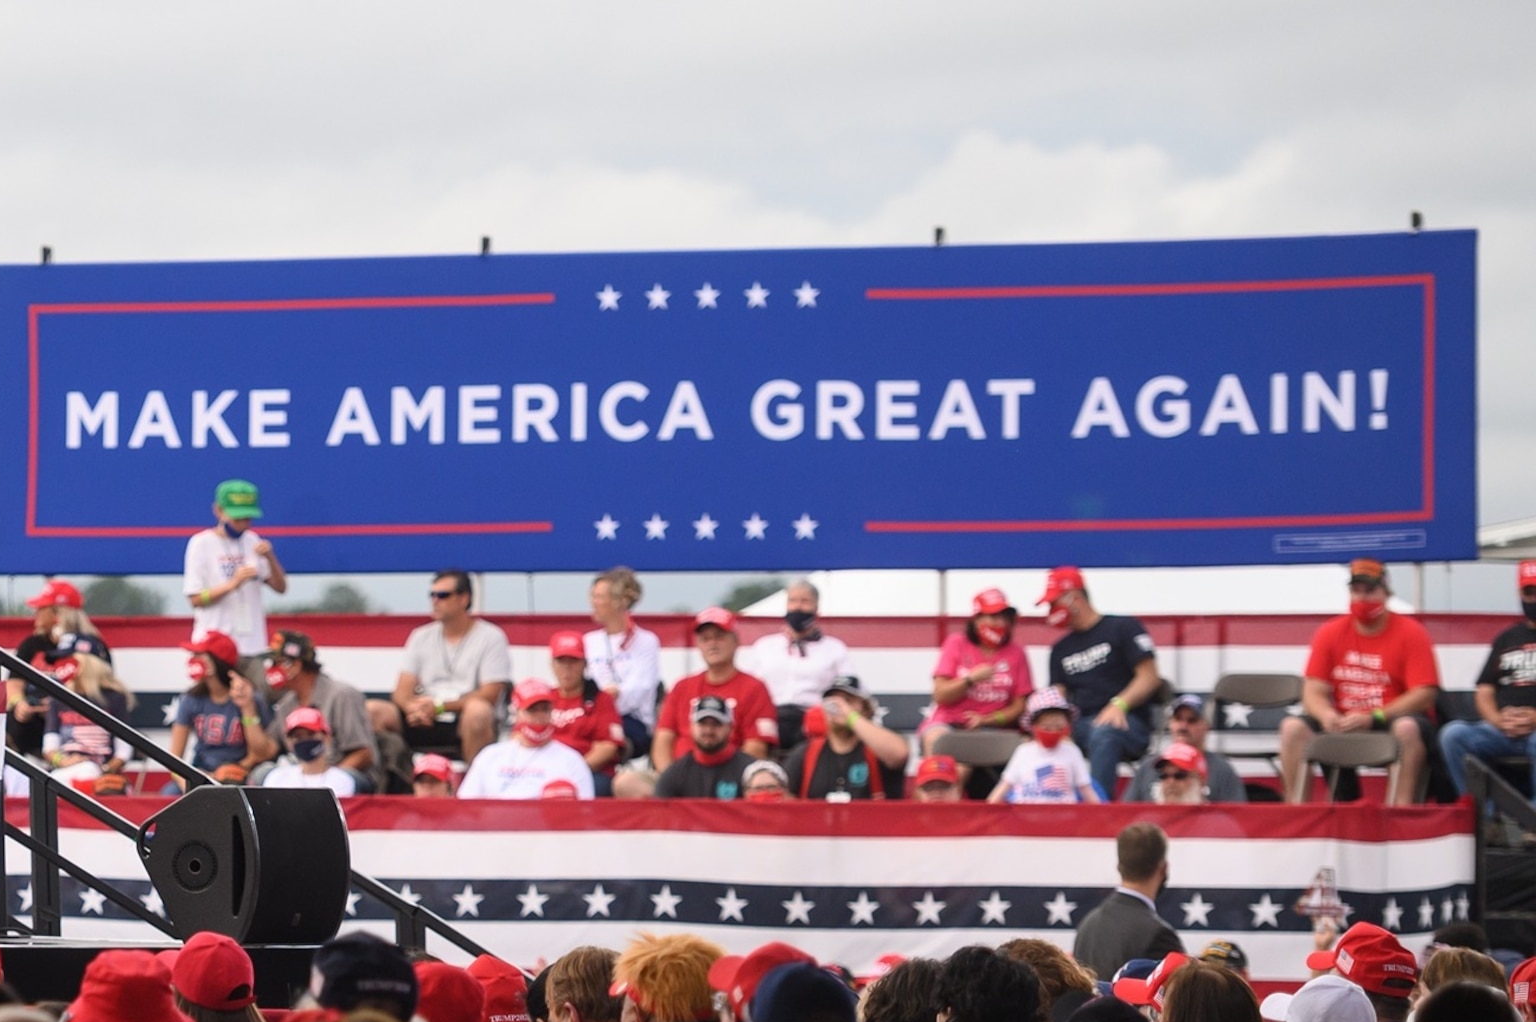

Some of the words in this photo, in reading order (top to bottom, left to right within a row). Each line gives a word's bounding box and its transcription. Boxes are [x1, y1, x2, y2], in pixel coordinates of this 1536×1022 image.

[65, 388, 291, 450] MAKE
[326, 381, 714, 446] AMERICA
[750, 378, 1036, 441] GREAT
[1071, 368, 1390, 439] AGAIN!
[194, 713, 244, 745] USA
